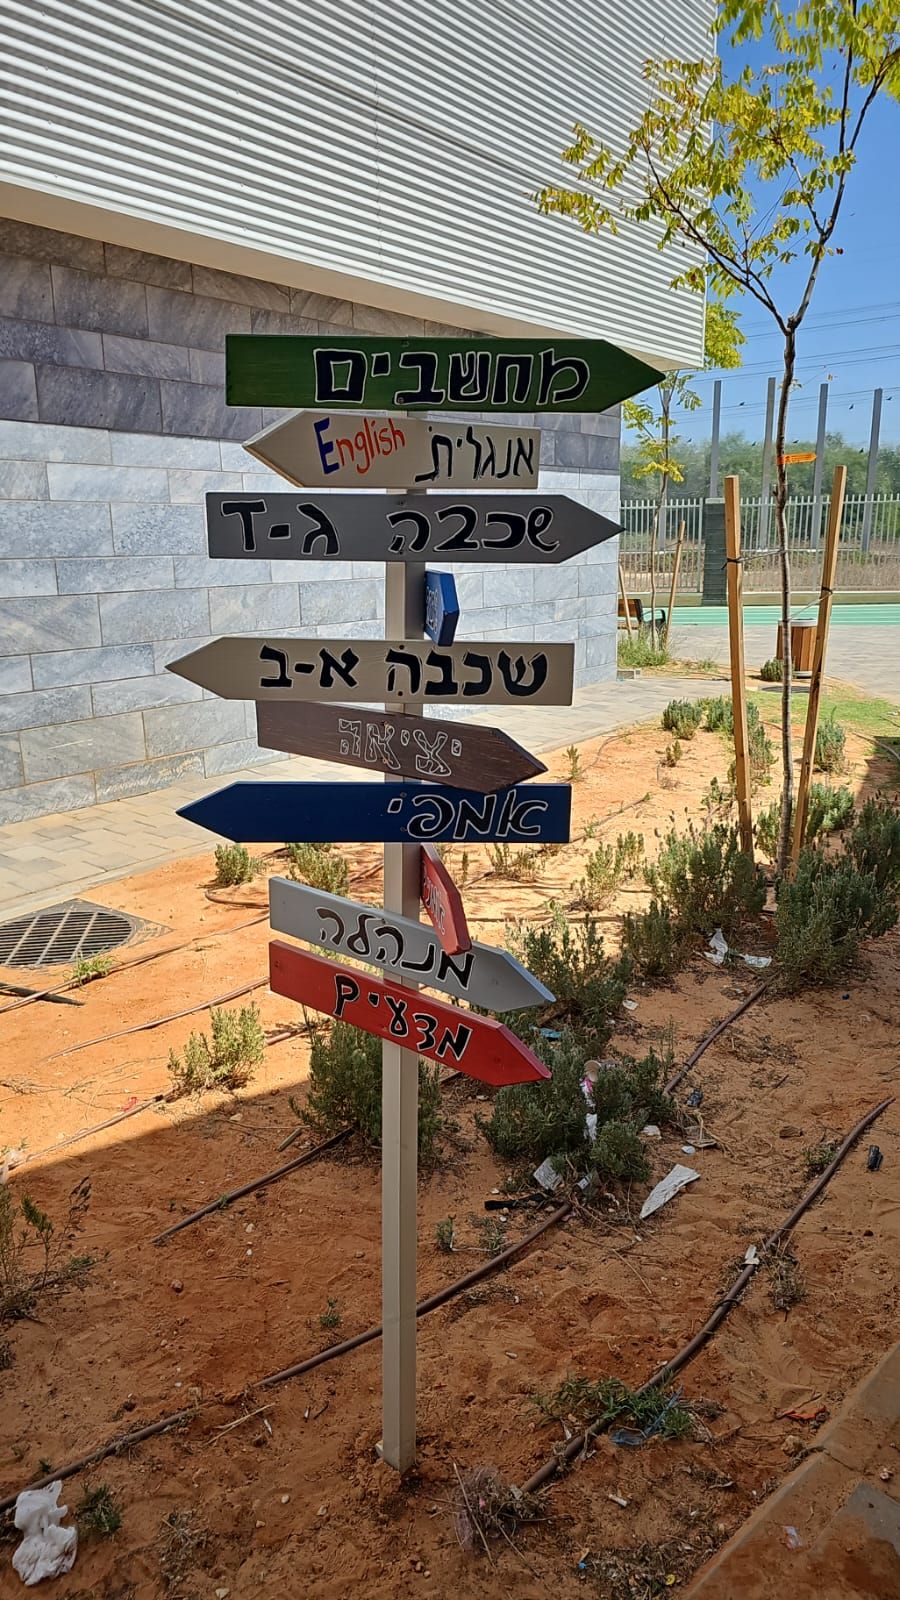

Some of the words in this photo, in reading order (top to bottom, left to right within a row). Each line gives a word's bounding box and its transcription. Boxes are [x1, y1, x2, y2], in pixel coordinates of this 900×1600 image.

[313, 348, 591, 405] מחשבים
[313, 417, 406, 474] English
[414, 426, 534, 483] אנגלית
[220, 500, 340, 556] ג-ד
[386, 504, 561, 554] שכבה
[258, 643, 360, 689] א-ב
[384, 647, 549, 697] שכבה
[338, 718, 463, 777] יציאה
[387, 789, 550, 840] אמפי
[315, 906, 475, 991] מנהלה
[333, 973, 474, 1061] מדעים
